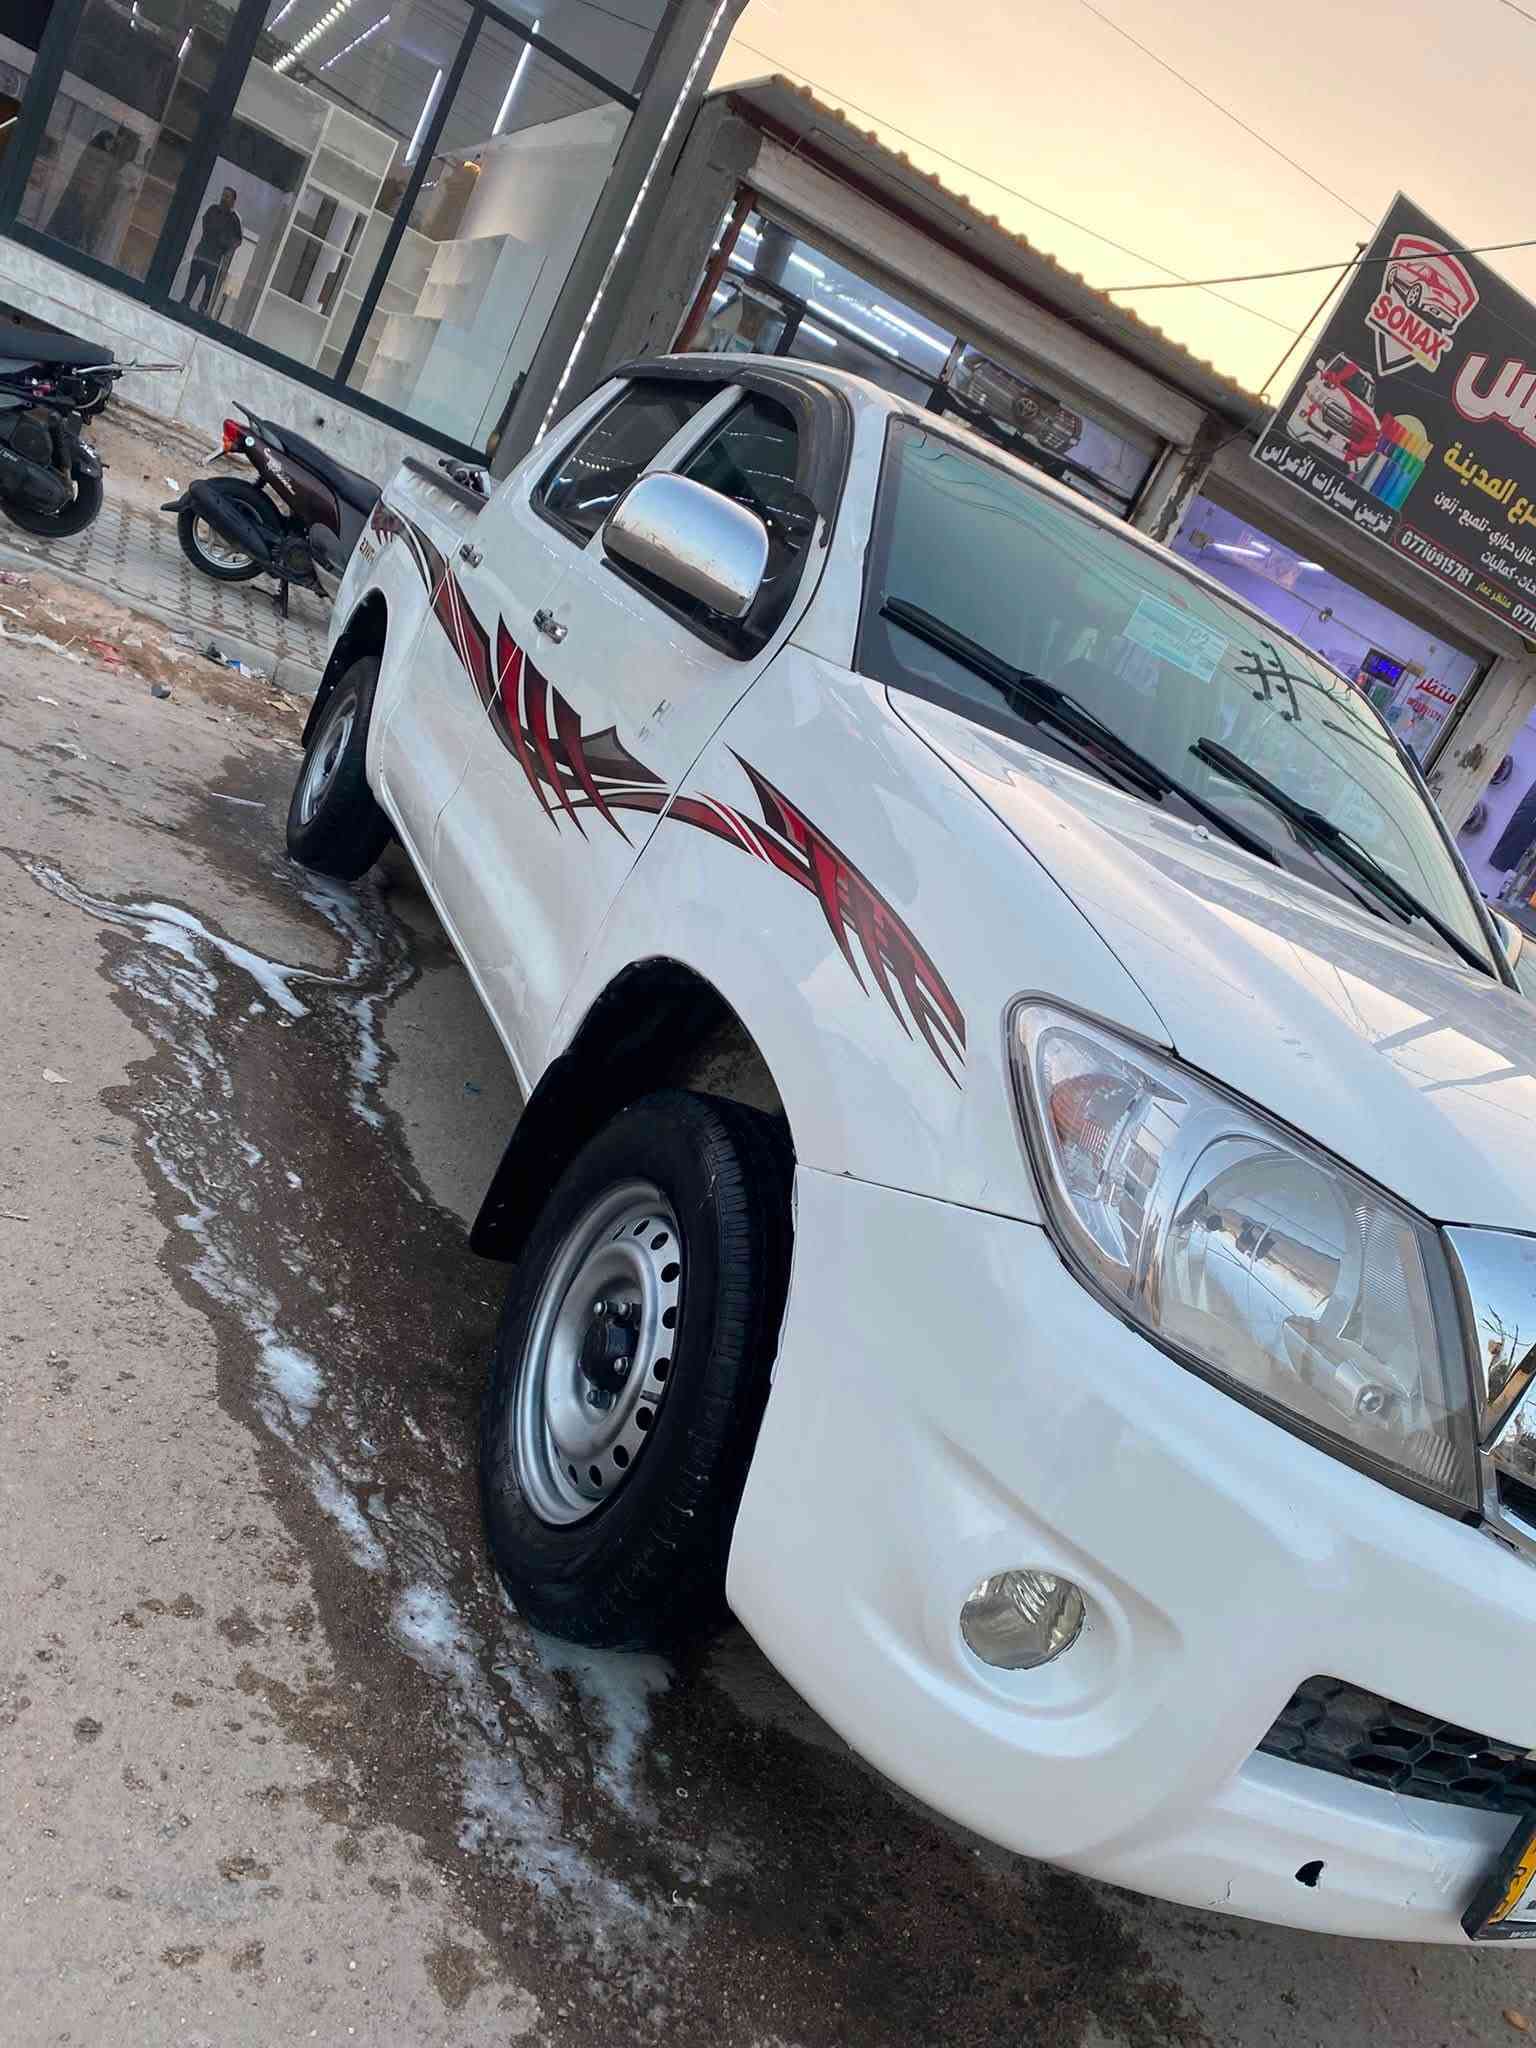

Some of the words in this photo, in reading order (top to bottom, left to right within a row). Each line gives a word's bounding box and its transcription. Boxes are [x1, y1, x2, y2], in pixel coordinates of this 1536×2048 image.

[1373, 295, 1447, 360] SONAX
[1311, 472, 1358, 511] سيارات
[1443, 441, 1518, 504] المدينة
[1353, 503, 1393, 533] تزيين
[1459, 509, 1488, 532] تلميع
[1401, 531, 1474, 586] 07710915781
[1415, 678, 1457, 704] منتظر
